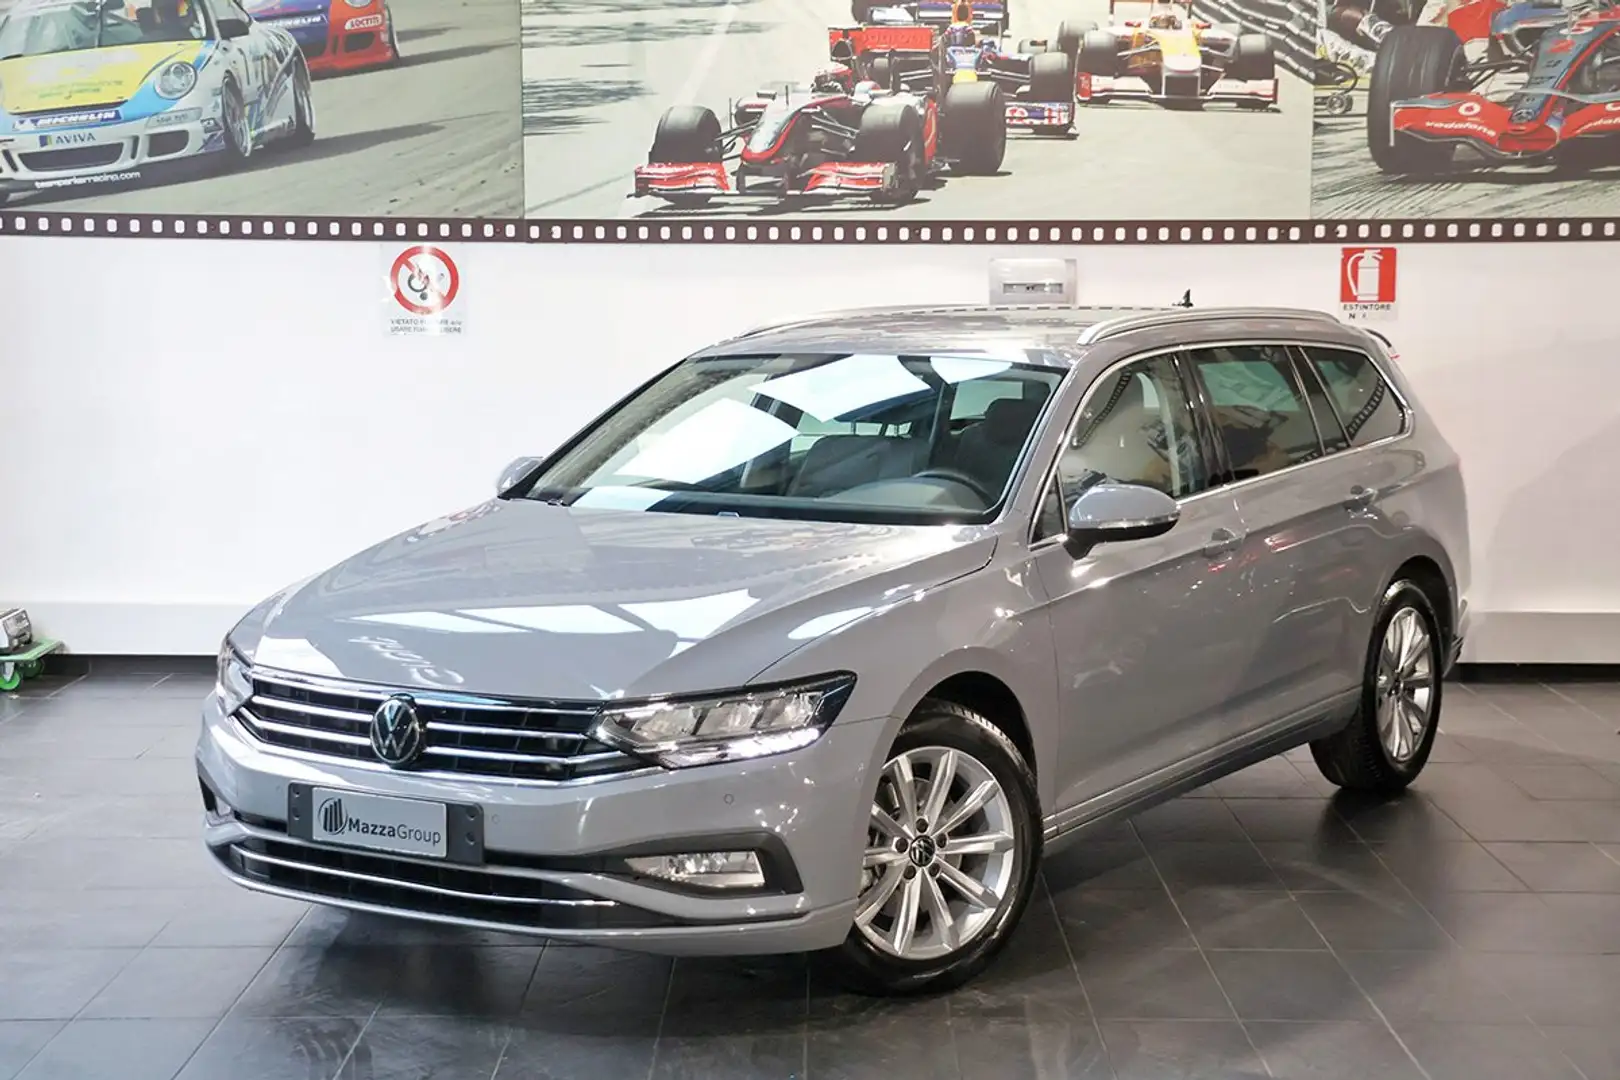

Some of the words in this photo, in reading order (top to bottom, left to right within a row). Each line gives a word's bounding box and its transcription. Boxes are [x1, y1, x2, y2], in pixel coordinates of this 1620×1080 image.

[38, 111, 116, 126] MICHELIN
[1425, 120, 1497, 138] vodafone
[55, 132, 97, 145] AVIVA
[348, 817, 441, 846] MazzaGroup
